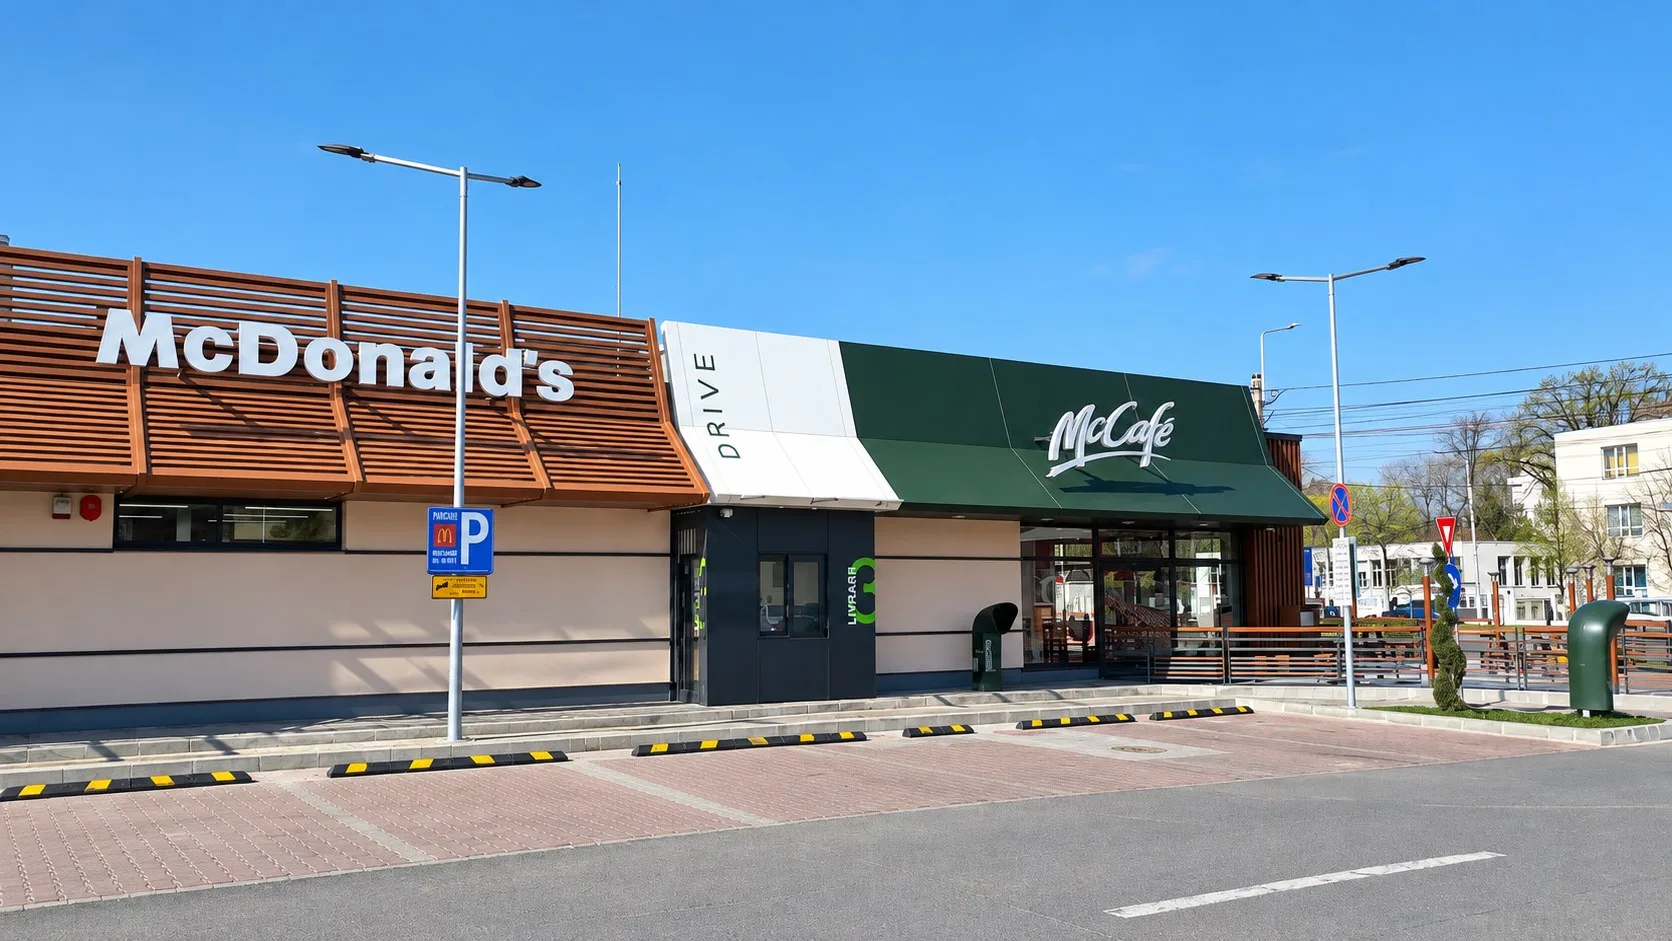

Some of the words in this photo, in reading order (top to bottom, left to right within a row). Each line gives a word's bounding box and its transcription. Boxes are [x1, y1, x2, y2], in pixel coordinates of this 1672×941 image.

[96, 308, 575, 402] McDonald's
[693, 353, 741, 459] DRIVE
[1046, 400, 1175, 477] McCafé
[460, 511, 489, 565] P
